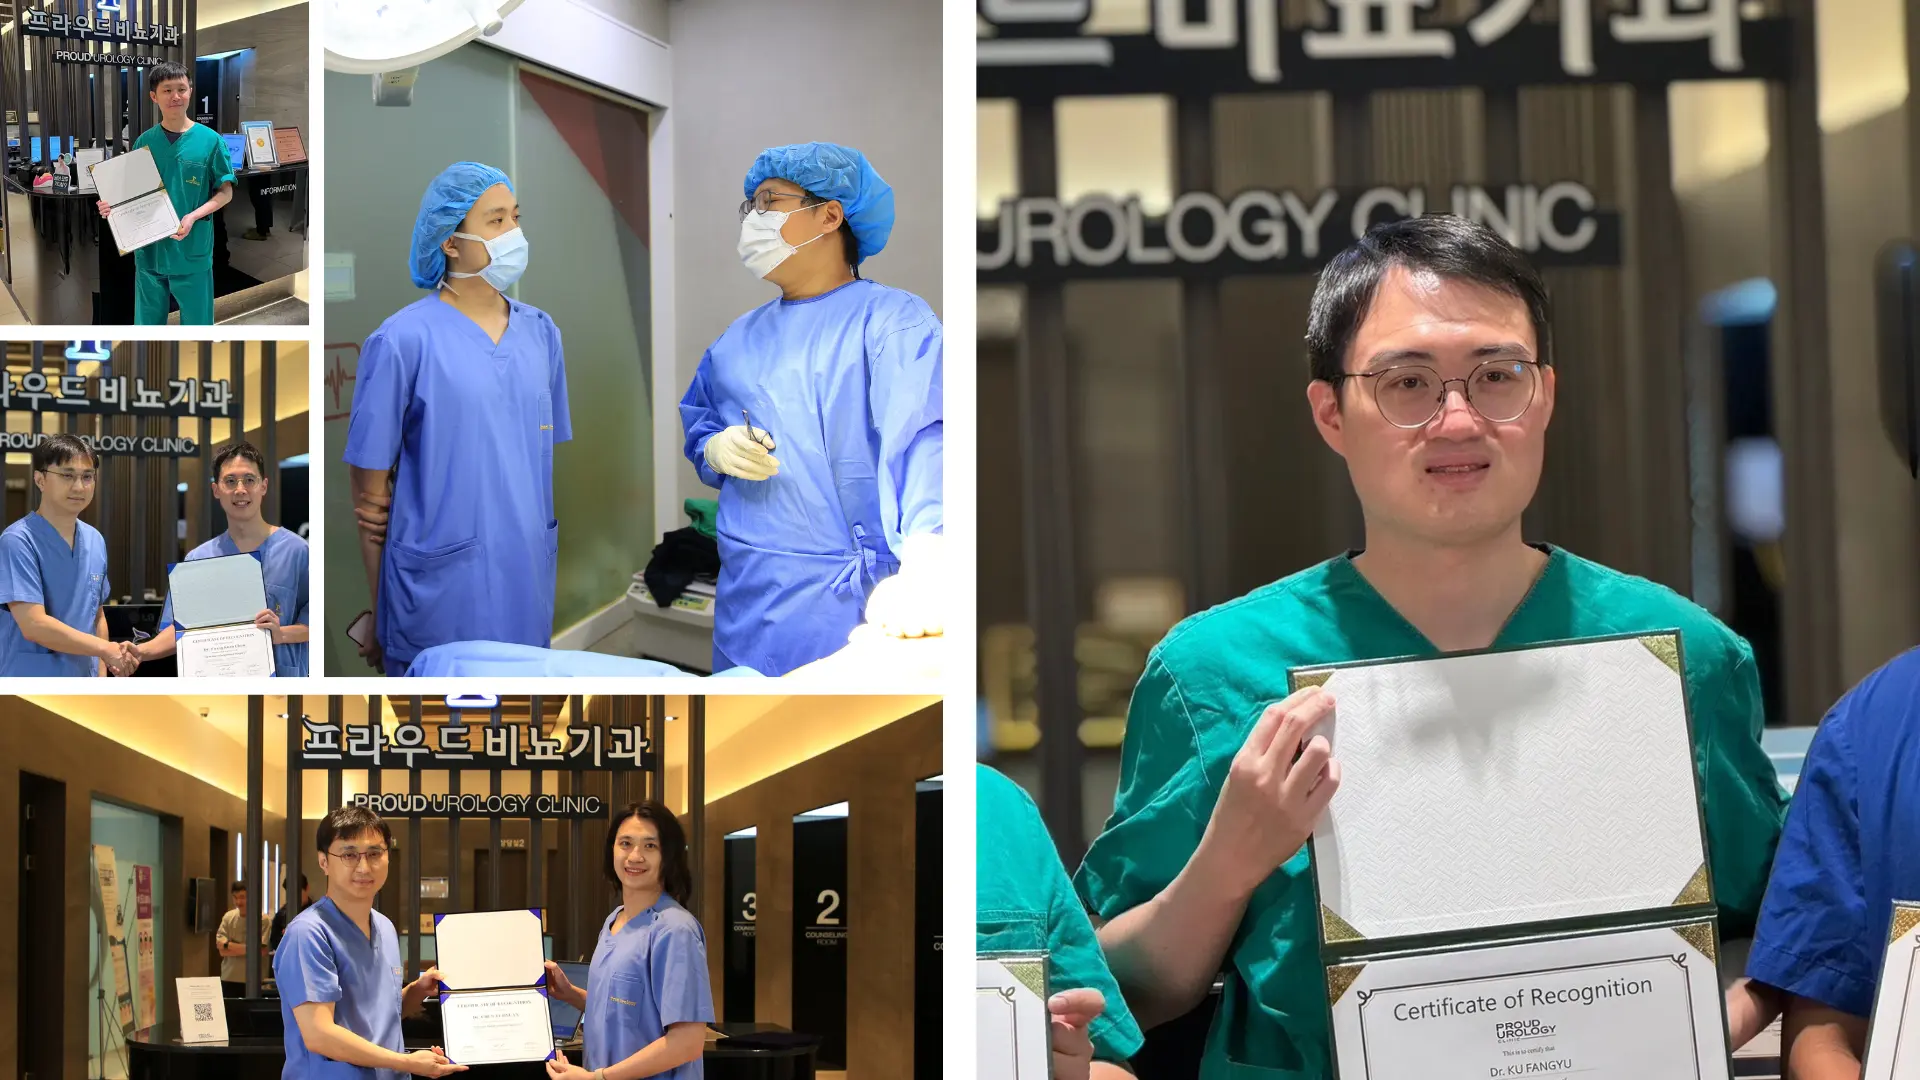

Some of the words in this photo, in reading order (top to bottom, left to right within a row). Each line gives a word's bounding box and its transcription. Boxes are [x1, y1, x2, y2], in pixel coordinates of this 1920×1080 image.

[56, 51, 91, 62] PROUD
[94, 53, 135, 64] UROLOGY
[137, 56, 162, 66] CLINIC
[202, 95, 209, 113] 1
[260, 184, 297, 195] INFORMATION
[80, 434, 138, 452] OLOGY
[141, 436, 195, 453] CLINIC
[354, 794, 427, 812] PROUD
[432, 795, 532, 813] UROLOGY
[536, 796, 600, 814] CLINIC
[742, 892, 756, 921] 3
[816, 889, 839, 925] 2
[1393, 996, 1497, 1021] Certificate
[1504, 989, 1525, 1009] of
[1531, 978, 1653, 1006] Recognition
[1495, 1019, 1541, 1031] PROUD
[1496, 1025, 1557, 1039] UROLOGY
[1490, 1067, 1505, 1077] Dr.
[1508, 1064, 1524, 1076] KU
[1526, 1059, 1572, 1073] FANGYU
